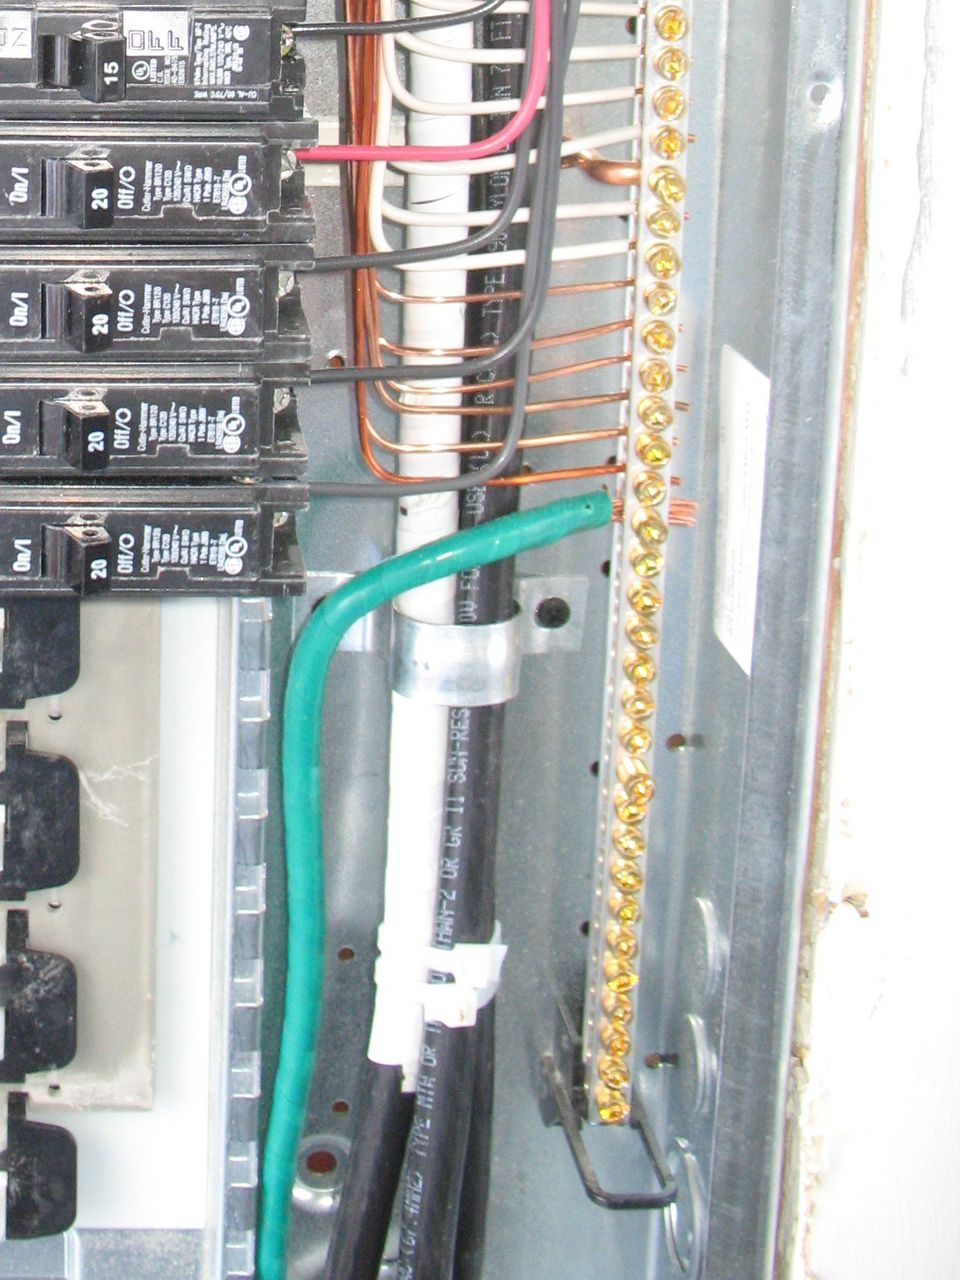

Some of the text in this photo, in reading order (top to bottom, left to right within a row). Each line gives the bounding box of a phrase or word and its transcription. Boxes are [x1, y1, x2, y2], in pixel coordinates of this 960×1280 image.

[104, 61, 121, 84] 15
[92, 188, 109, 210] 20
[92, 314, 109, 335] 20
[88, 431, 105, 452] 20
[91, 558, 108, 580] 20
